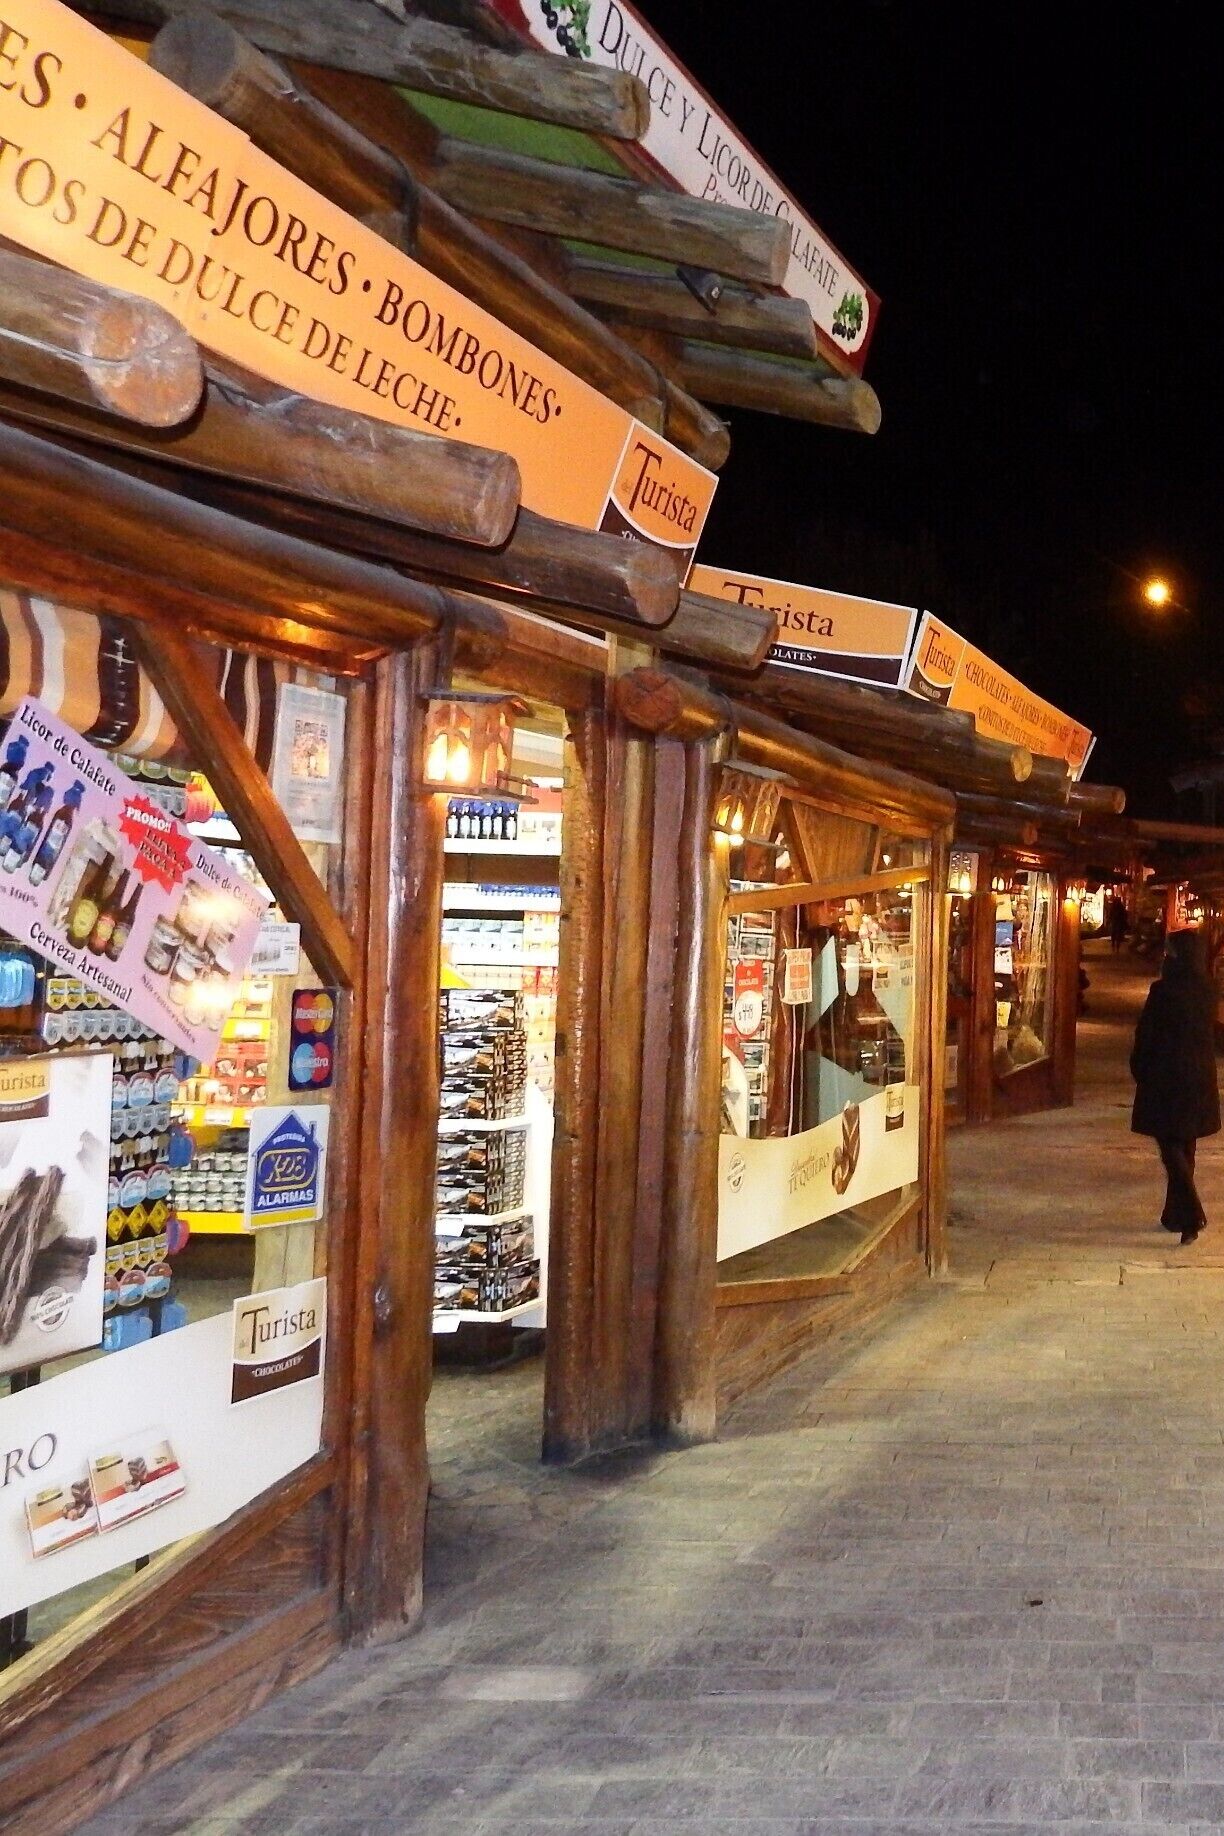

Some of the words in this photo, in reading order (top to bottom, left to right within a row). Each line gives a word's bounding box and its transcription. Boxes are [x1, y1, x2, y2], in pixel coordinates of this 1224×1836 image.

[681, 96, 695, 133] Y
[697, 112, 751, 194] LICOR
[775, 199, 840, 299] CLAFATE
[90, 107, 356, 295] ALFAJORES
[374, 278, 557, 424] BOMBONES
[85, 196, 157, 268] DE
[157, 237, 300, 345] DULCE
[300, 317, 353, 374] DE
[352, 347, 456, 432] LECHE
[629, 441, 698, 534] Turista
[924, 626, 956, 677] Turista
[20, 704, 53, 742] Licor
[53, 736, 70, 757] de
[70, 748, 117, 797] Calafate
[196, 854, 221, 883] Dulce
[221, 877, 232, 894] de
[30, 921, 77, 966] Cerveza
[77, 955, 134, 1004] Artesanal
[0, 1068, 46, 1092] urista
[257, 1188, 314, 1207] ALARMAS
[241, 1306, 316, 1354] Turista
[1, 1432, 57, 1488] RO
